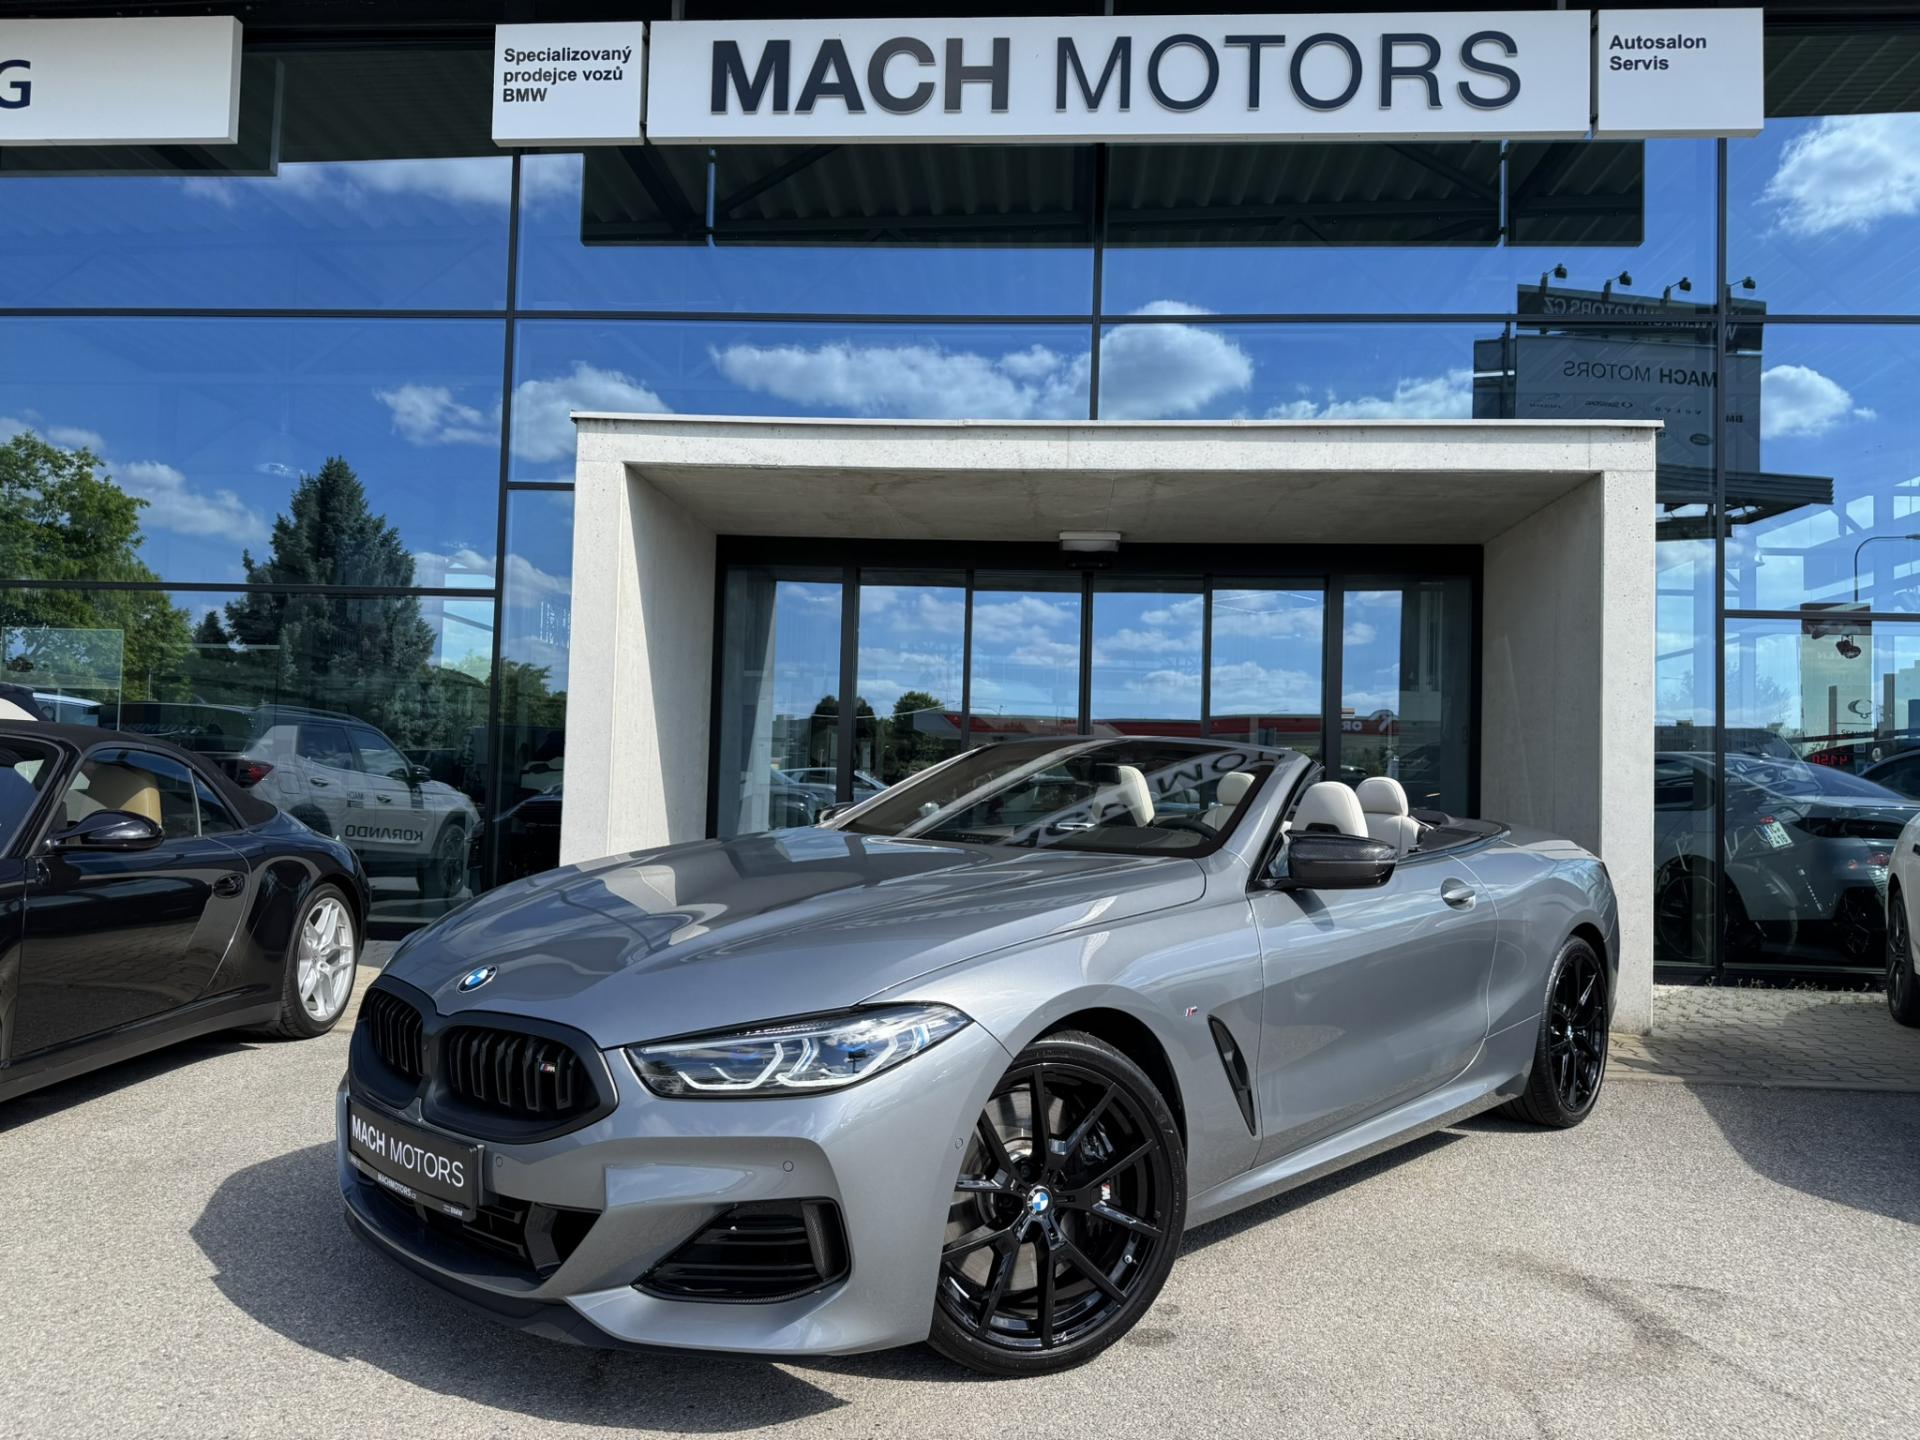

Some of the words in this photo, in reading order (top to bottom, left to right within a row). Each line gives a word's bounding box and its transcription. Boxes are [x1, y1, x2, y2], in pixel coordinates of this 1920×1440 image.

[1609, 33, 1707, 50] Autosalon
[503, 45, 632, 66] Specializovaný
[1609, 55, 1670, 71] Servis
[503, 67, 578, 86] prodejce
[582, 65, 623, 81] vozů
[711, 37, 1010, 115] MACH
[1056, 31, 1521, 113] MOTORS
[502, 87, 548, 103] BMW
[351, 1114, 386, 1157] MACH
[390, 1136, 465, 1188] MOTORS
